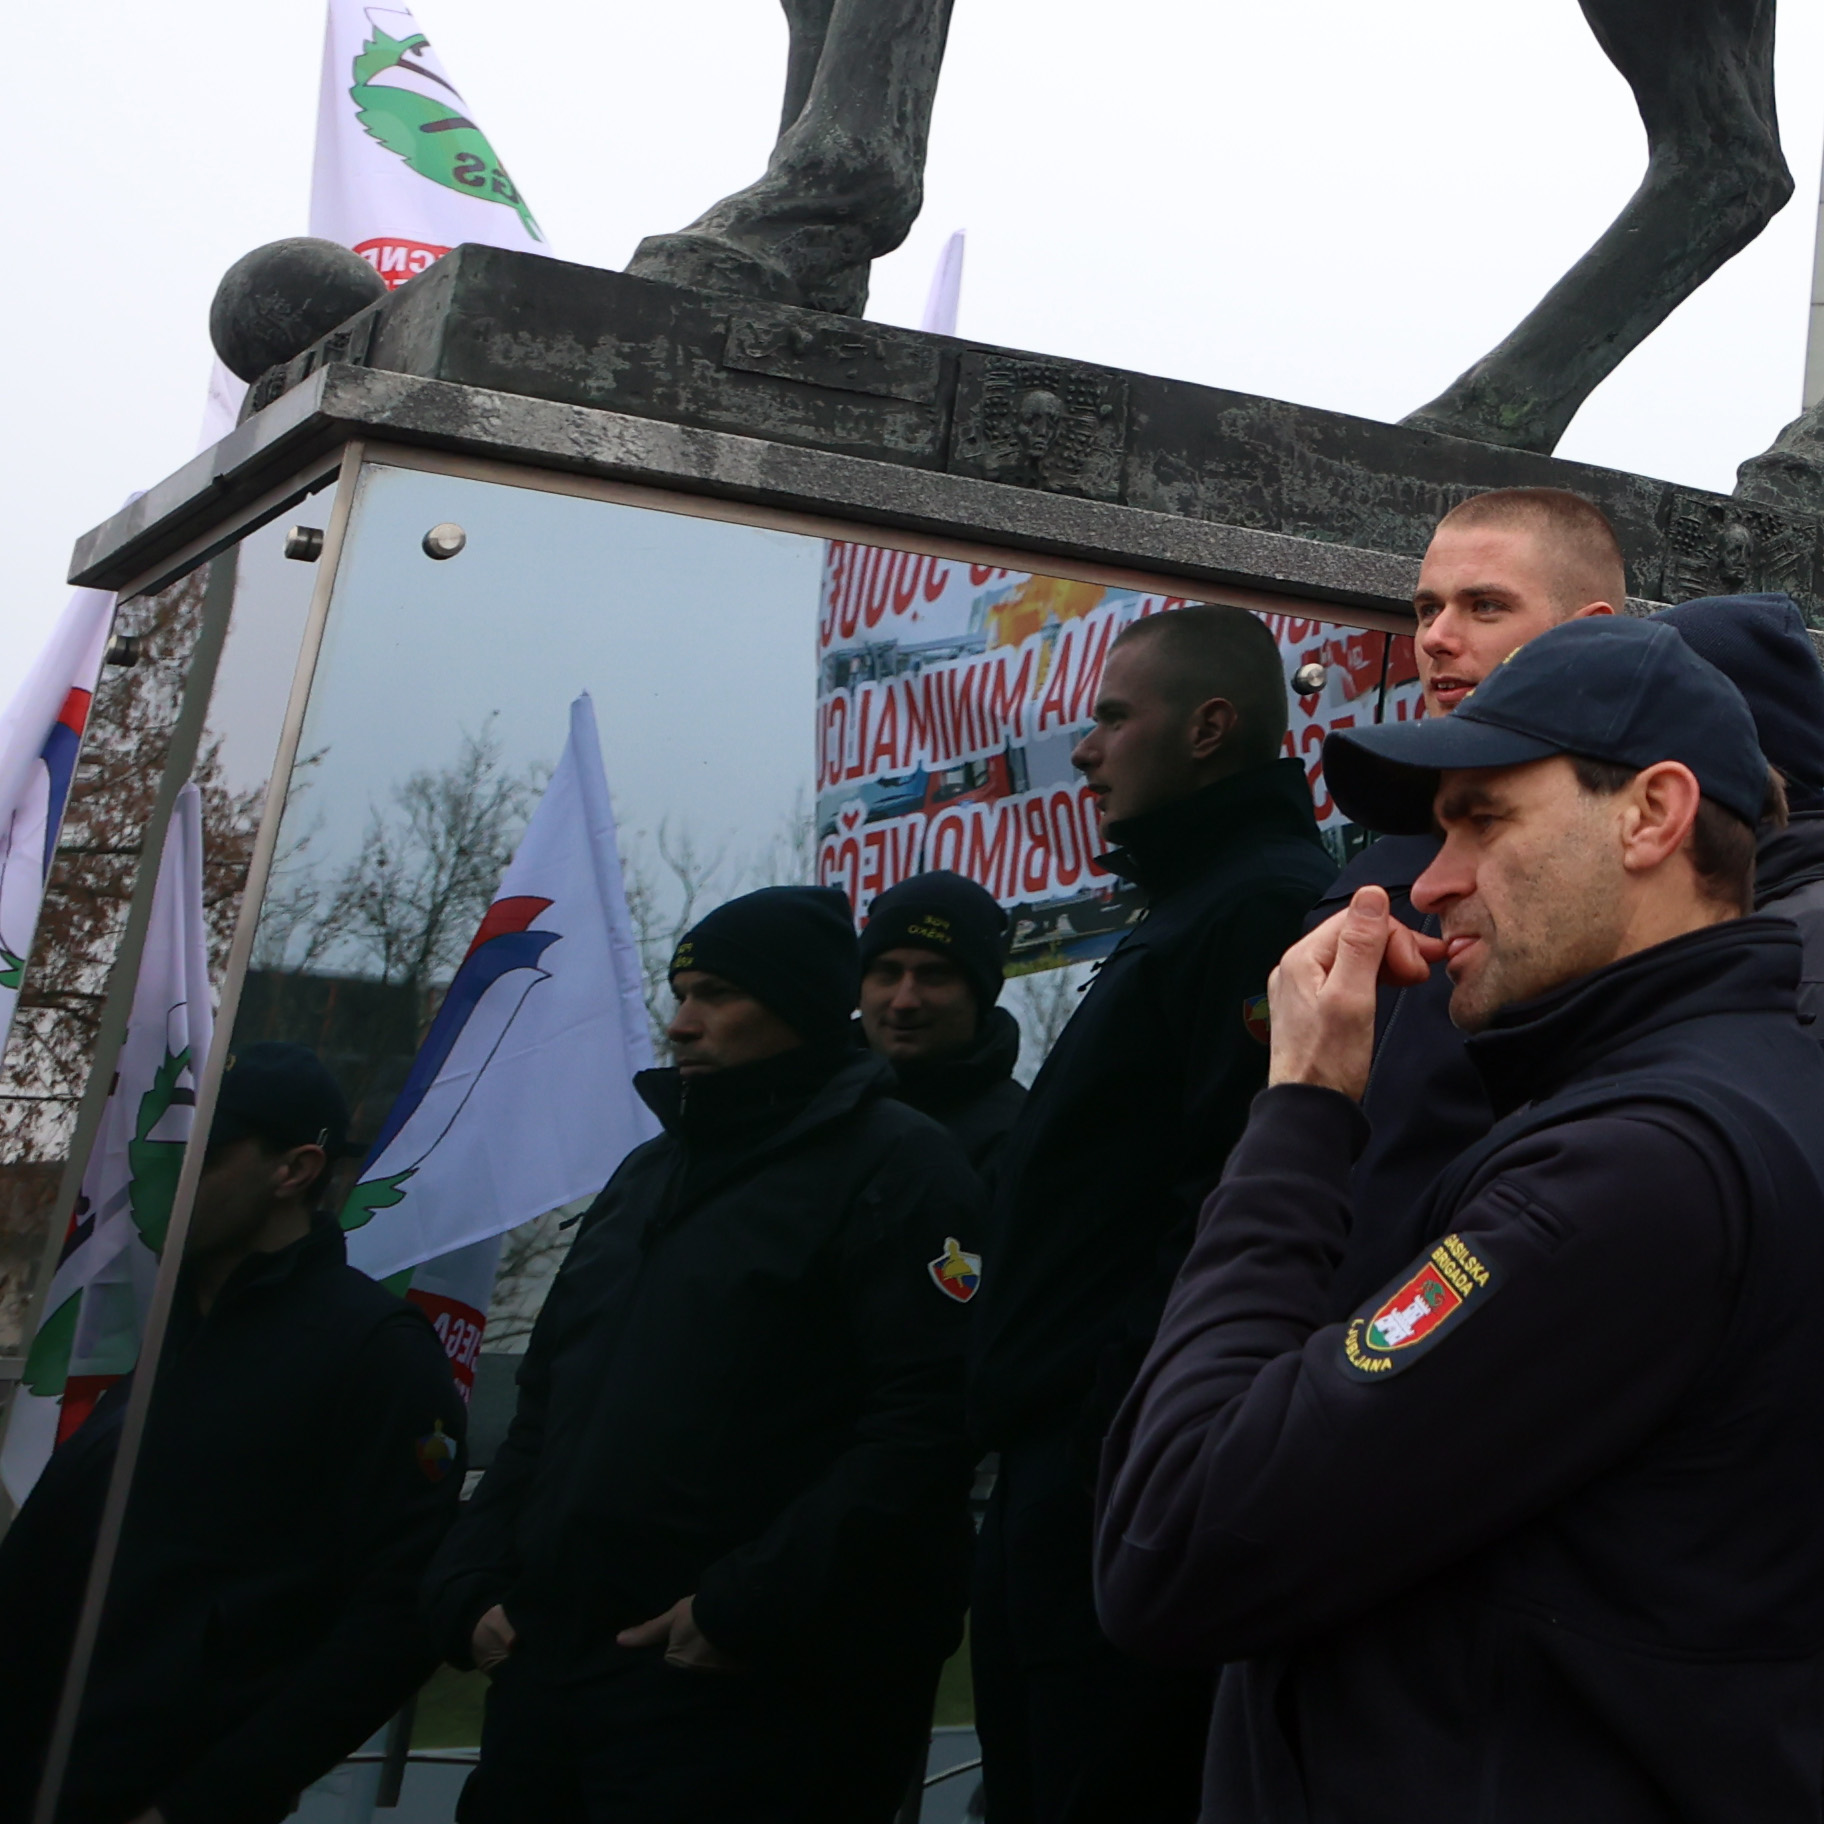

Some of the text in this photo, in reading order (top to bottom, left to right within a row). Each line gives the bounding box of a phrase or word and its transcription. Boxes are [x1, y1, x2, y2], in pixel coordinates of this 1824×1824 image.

[1431, 1245, 1475, 1297] BRIGADA
[1443, 1233, 1491, 1288] GASILSKA
[1344, 1318, 1393, 1373] LJUBLJANA
